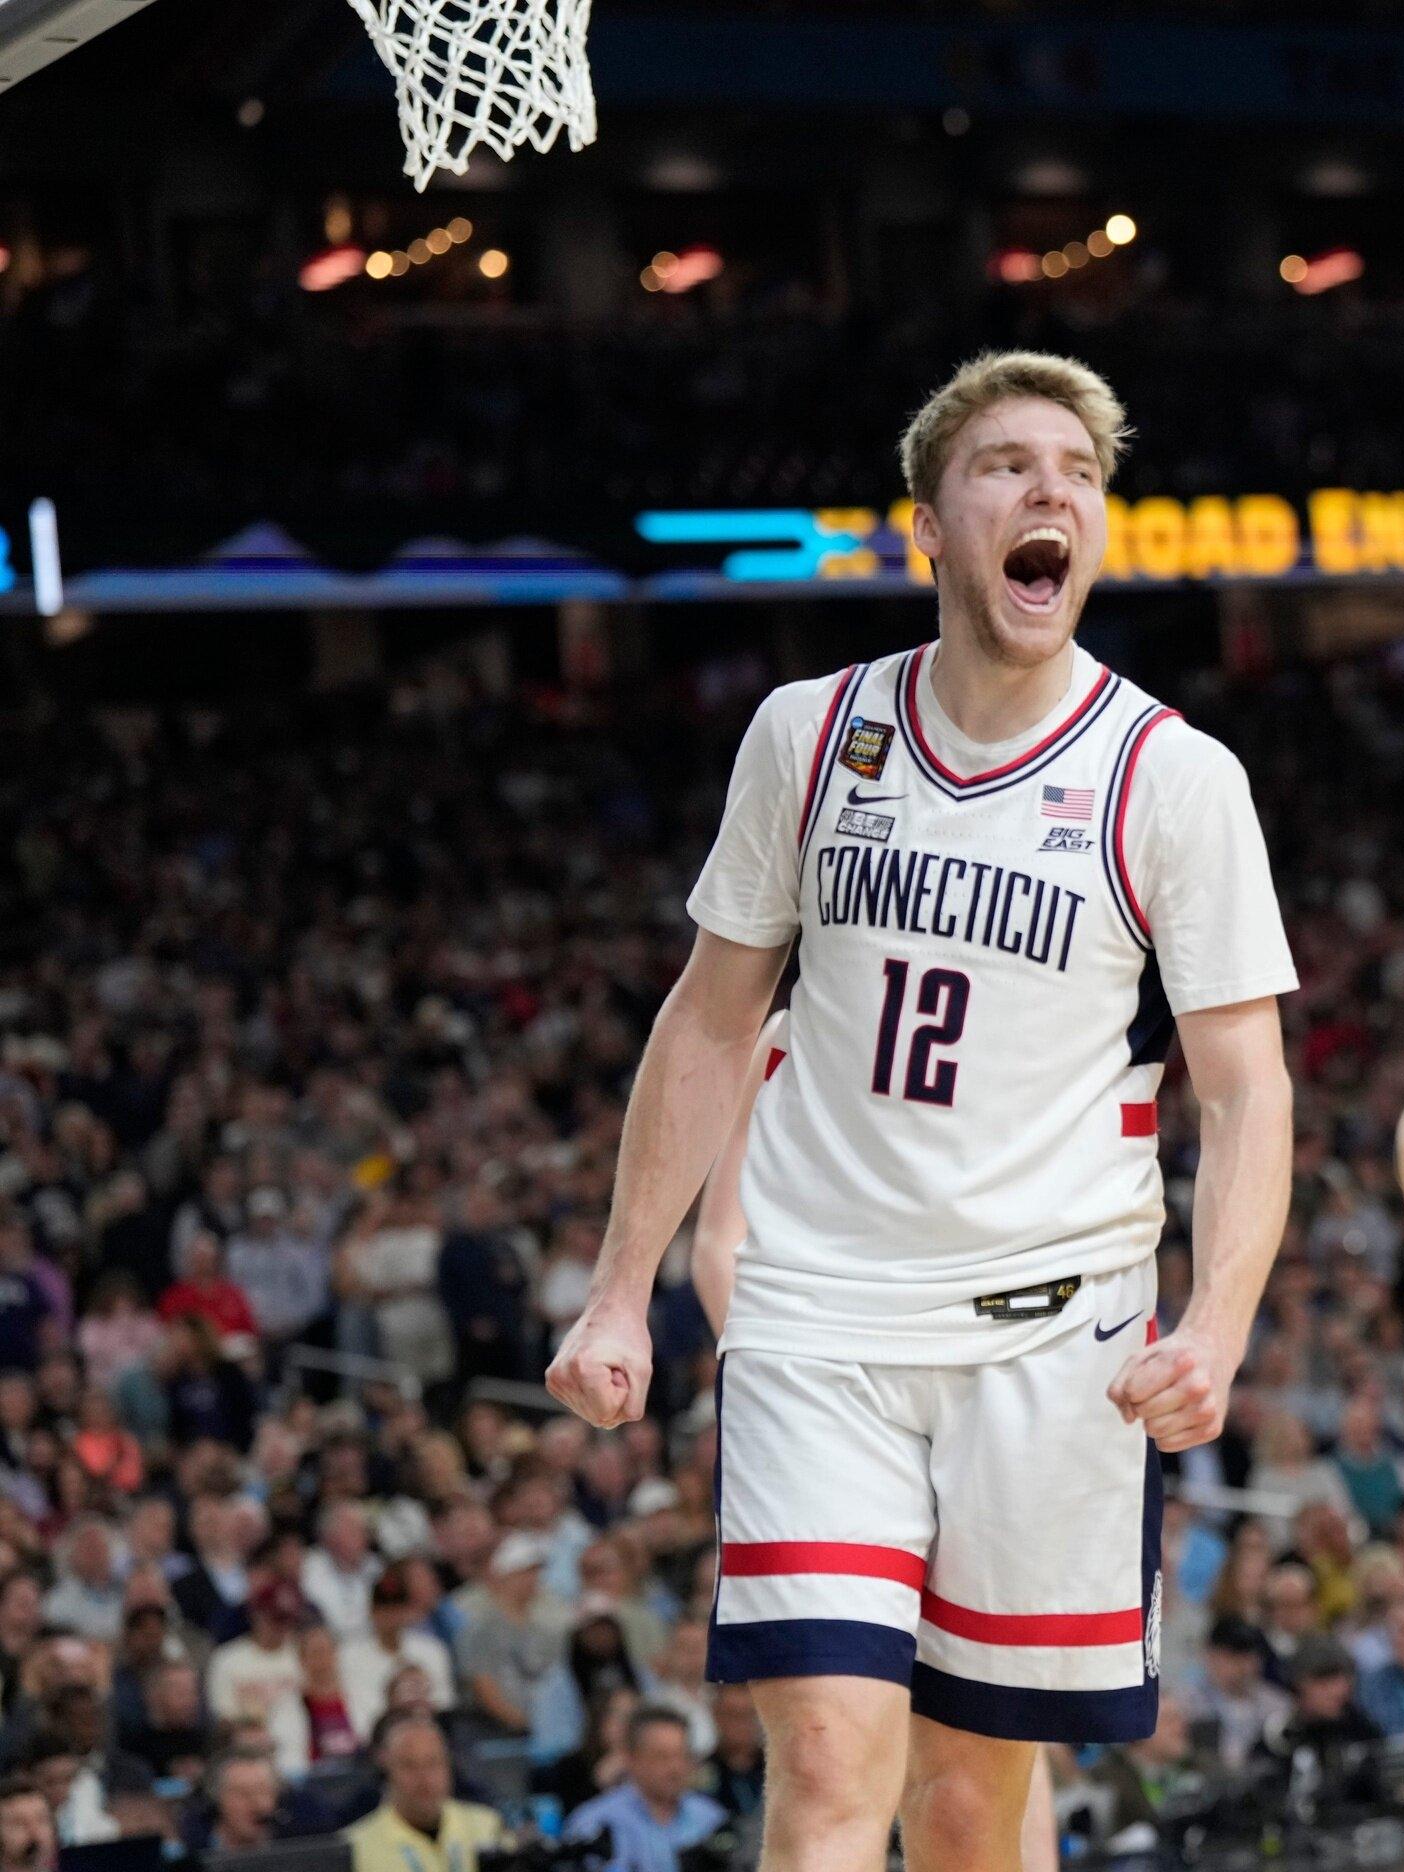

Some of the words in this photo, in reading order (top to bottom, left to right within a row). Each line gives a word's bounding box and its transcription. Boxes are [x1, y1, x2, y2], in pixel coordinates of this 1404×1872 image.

[1043, 838, 1095, 850] EAST
[1049, 826, 1086, 840] BIG
[817, 846, 1086, 972] CONNECTICUT
[871, 958, 971, 1108] 12
